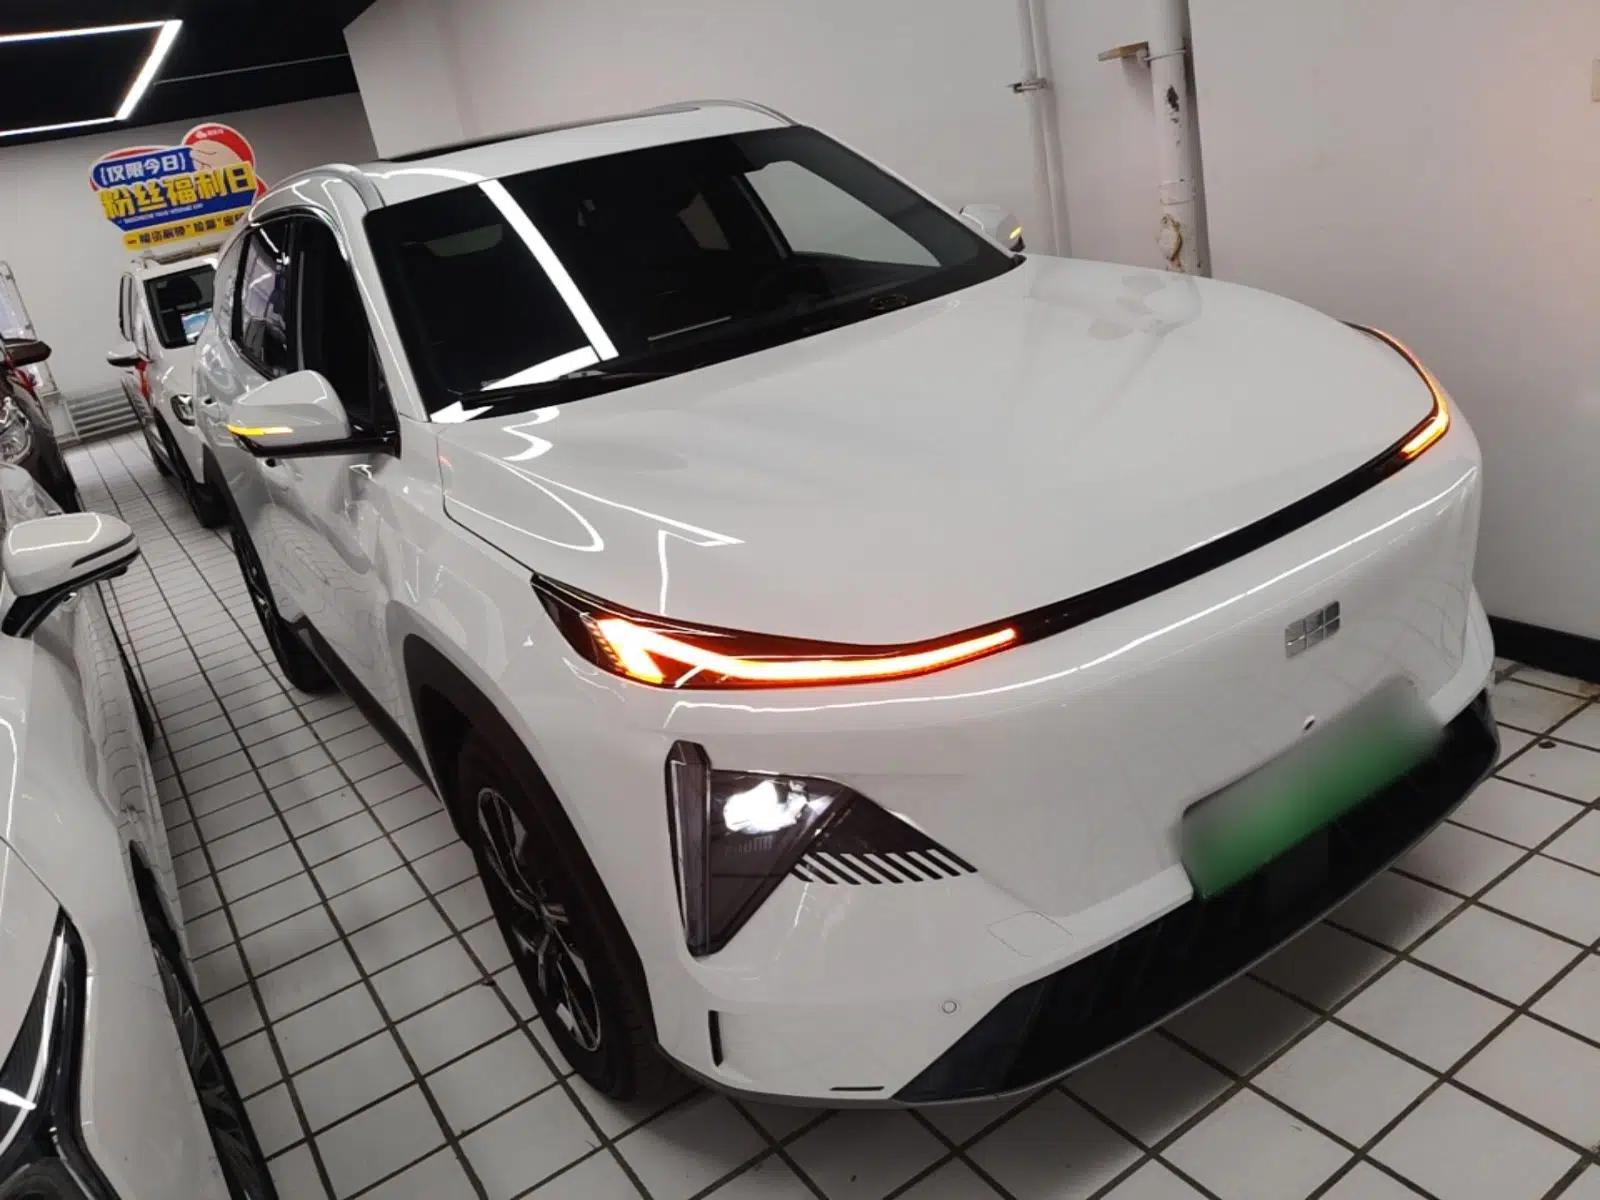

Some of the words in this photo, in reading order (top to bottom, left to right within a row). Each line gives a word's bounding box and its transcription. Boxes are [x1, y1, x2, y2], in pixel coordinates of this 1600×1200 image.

[100, 162, 256, 218] 粉丝福利日
